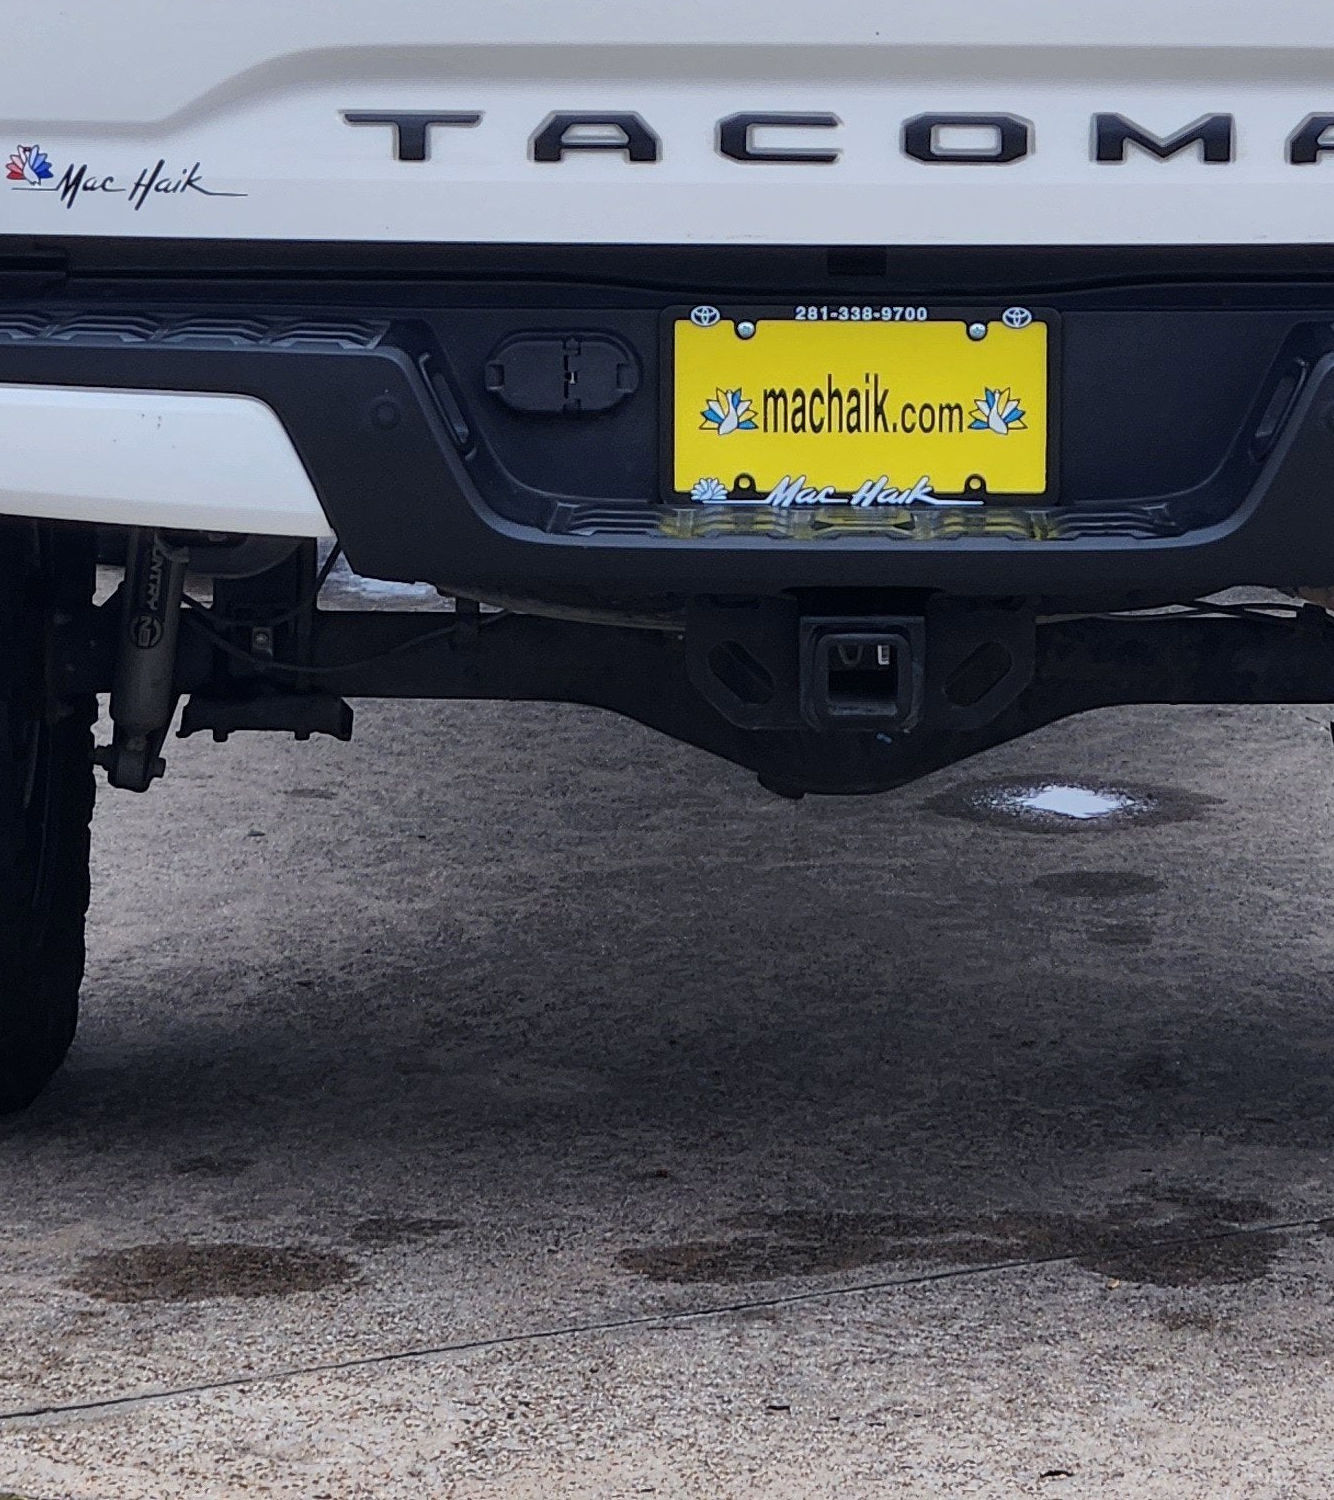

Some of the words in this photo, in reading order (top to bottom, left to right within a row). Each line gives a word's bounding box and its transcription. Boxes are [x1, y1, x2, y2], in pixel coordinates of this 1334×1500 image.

[56, 162, 126, 209] Mac
[128, 159, 249, 211] Haik
[794, 306, 929, 321] 281-338-9700
[762, 373, 964, 435] machaik.com
[765, 474, 849, 508] Mac
[850, 474, 984, 508] Haik
